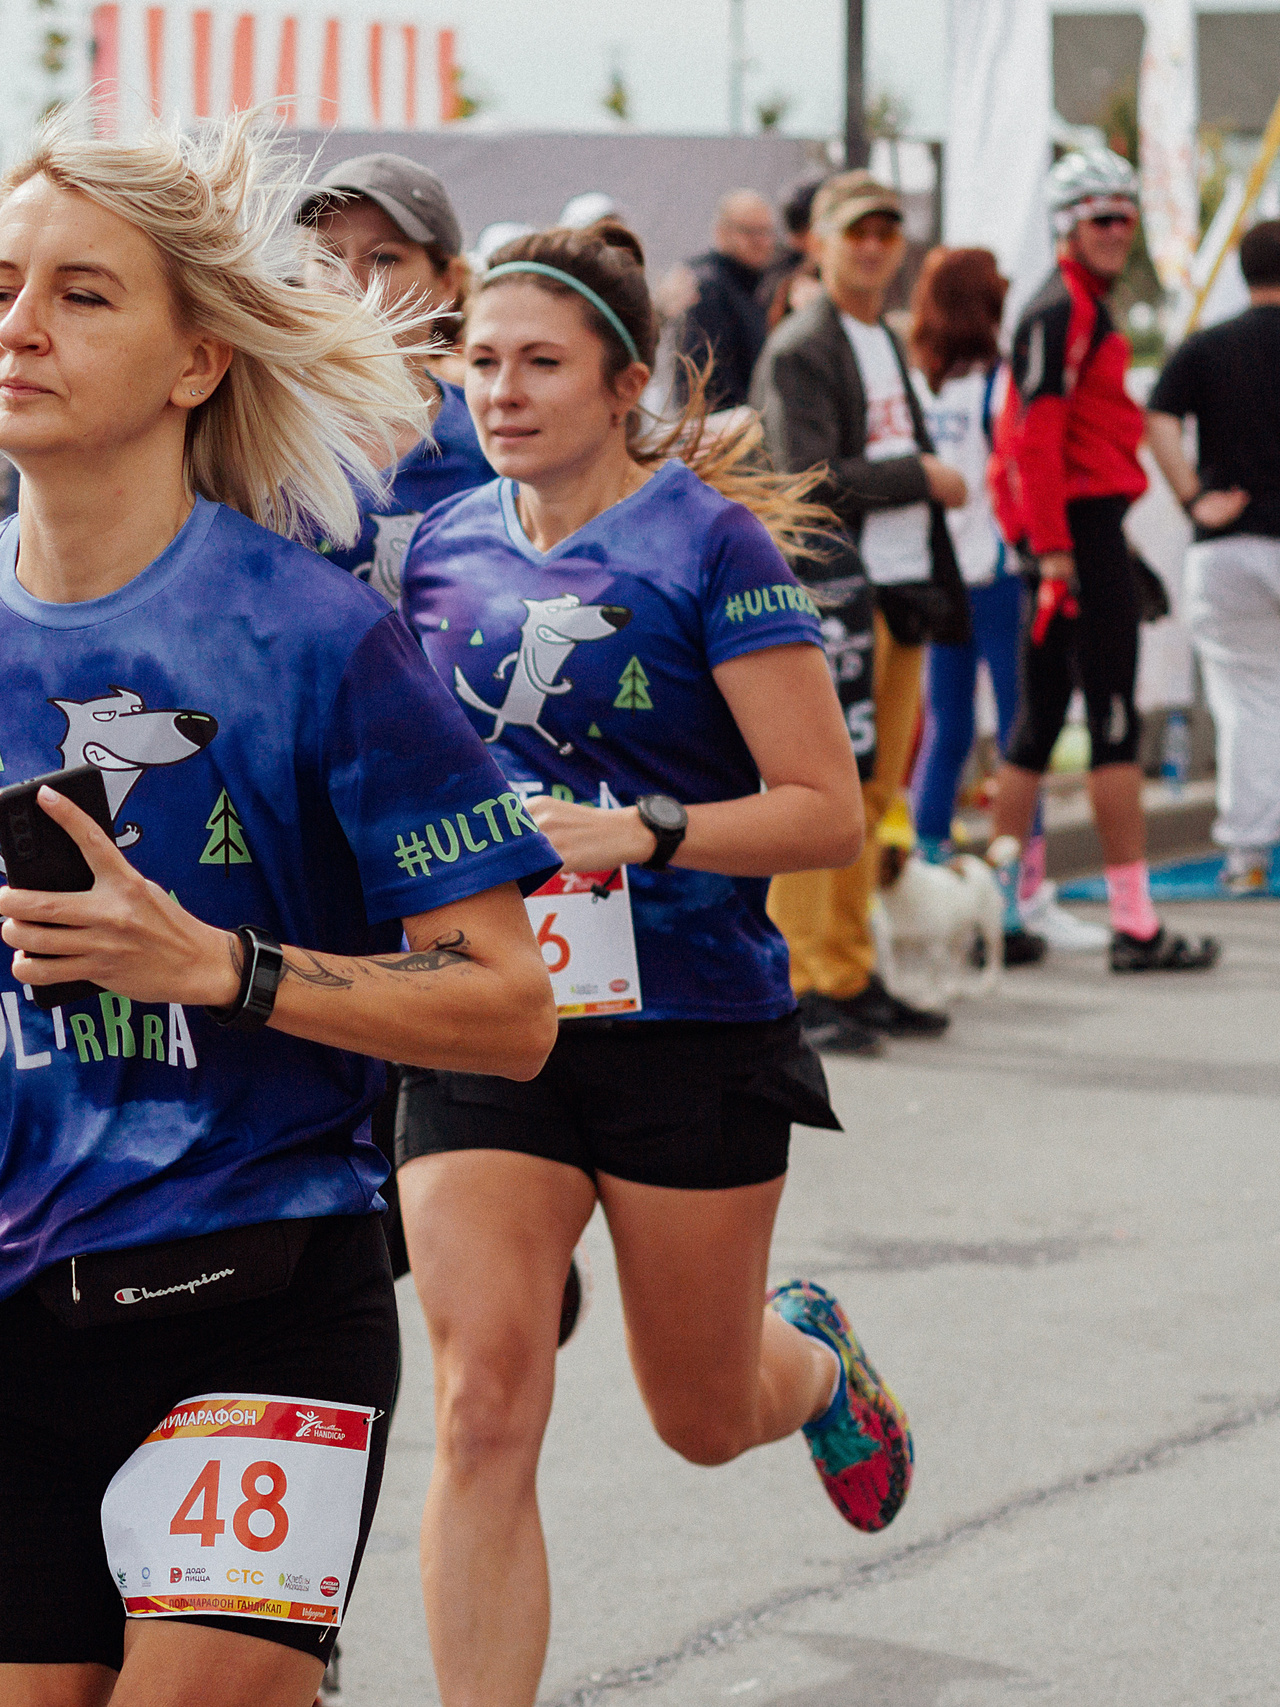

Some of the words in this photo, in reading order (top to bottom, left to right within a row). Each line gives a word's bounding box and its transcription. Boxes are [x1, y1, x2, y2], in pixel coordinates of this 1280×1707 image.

[394, 791, 540, 877] #ULTR
[114, 1268, 235, 1305] Champion
[313, 1429, 346, 1441] HANDICAP
[169, 1459, 289, 1553] 48
[168, 1597, 234, 1609] ПОЛУМАРАФОН
[237, 1598, 282, 1614] ГАНДИКАП
